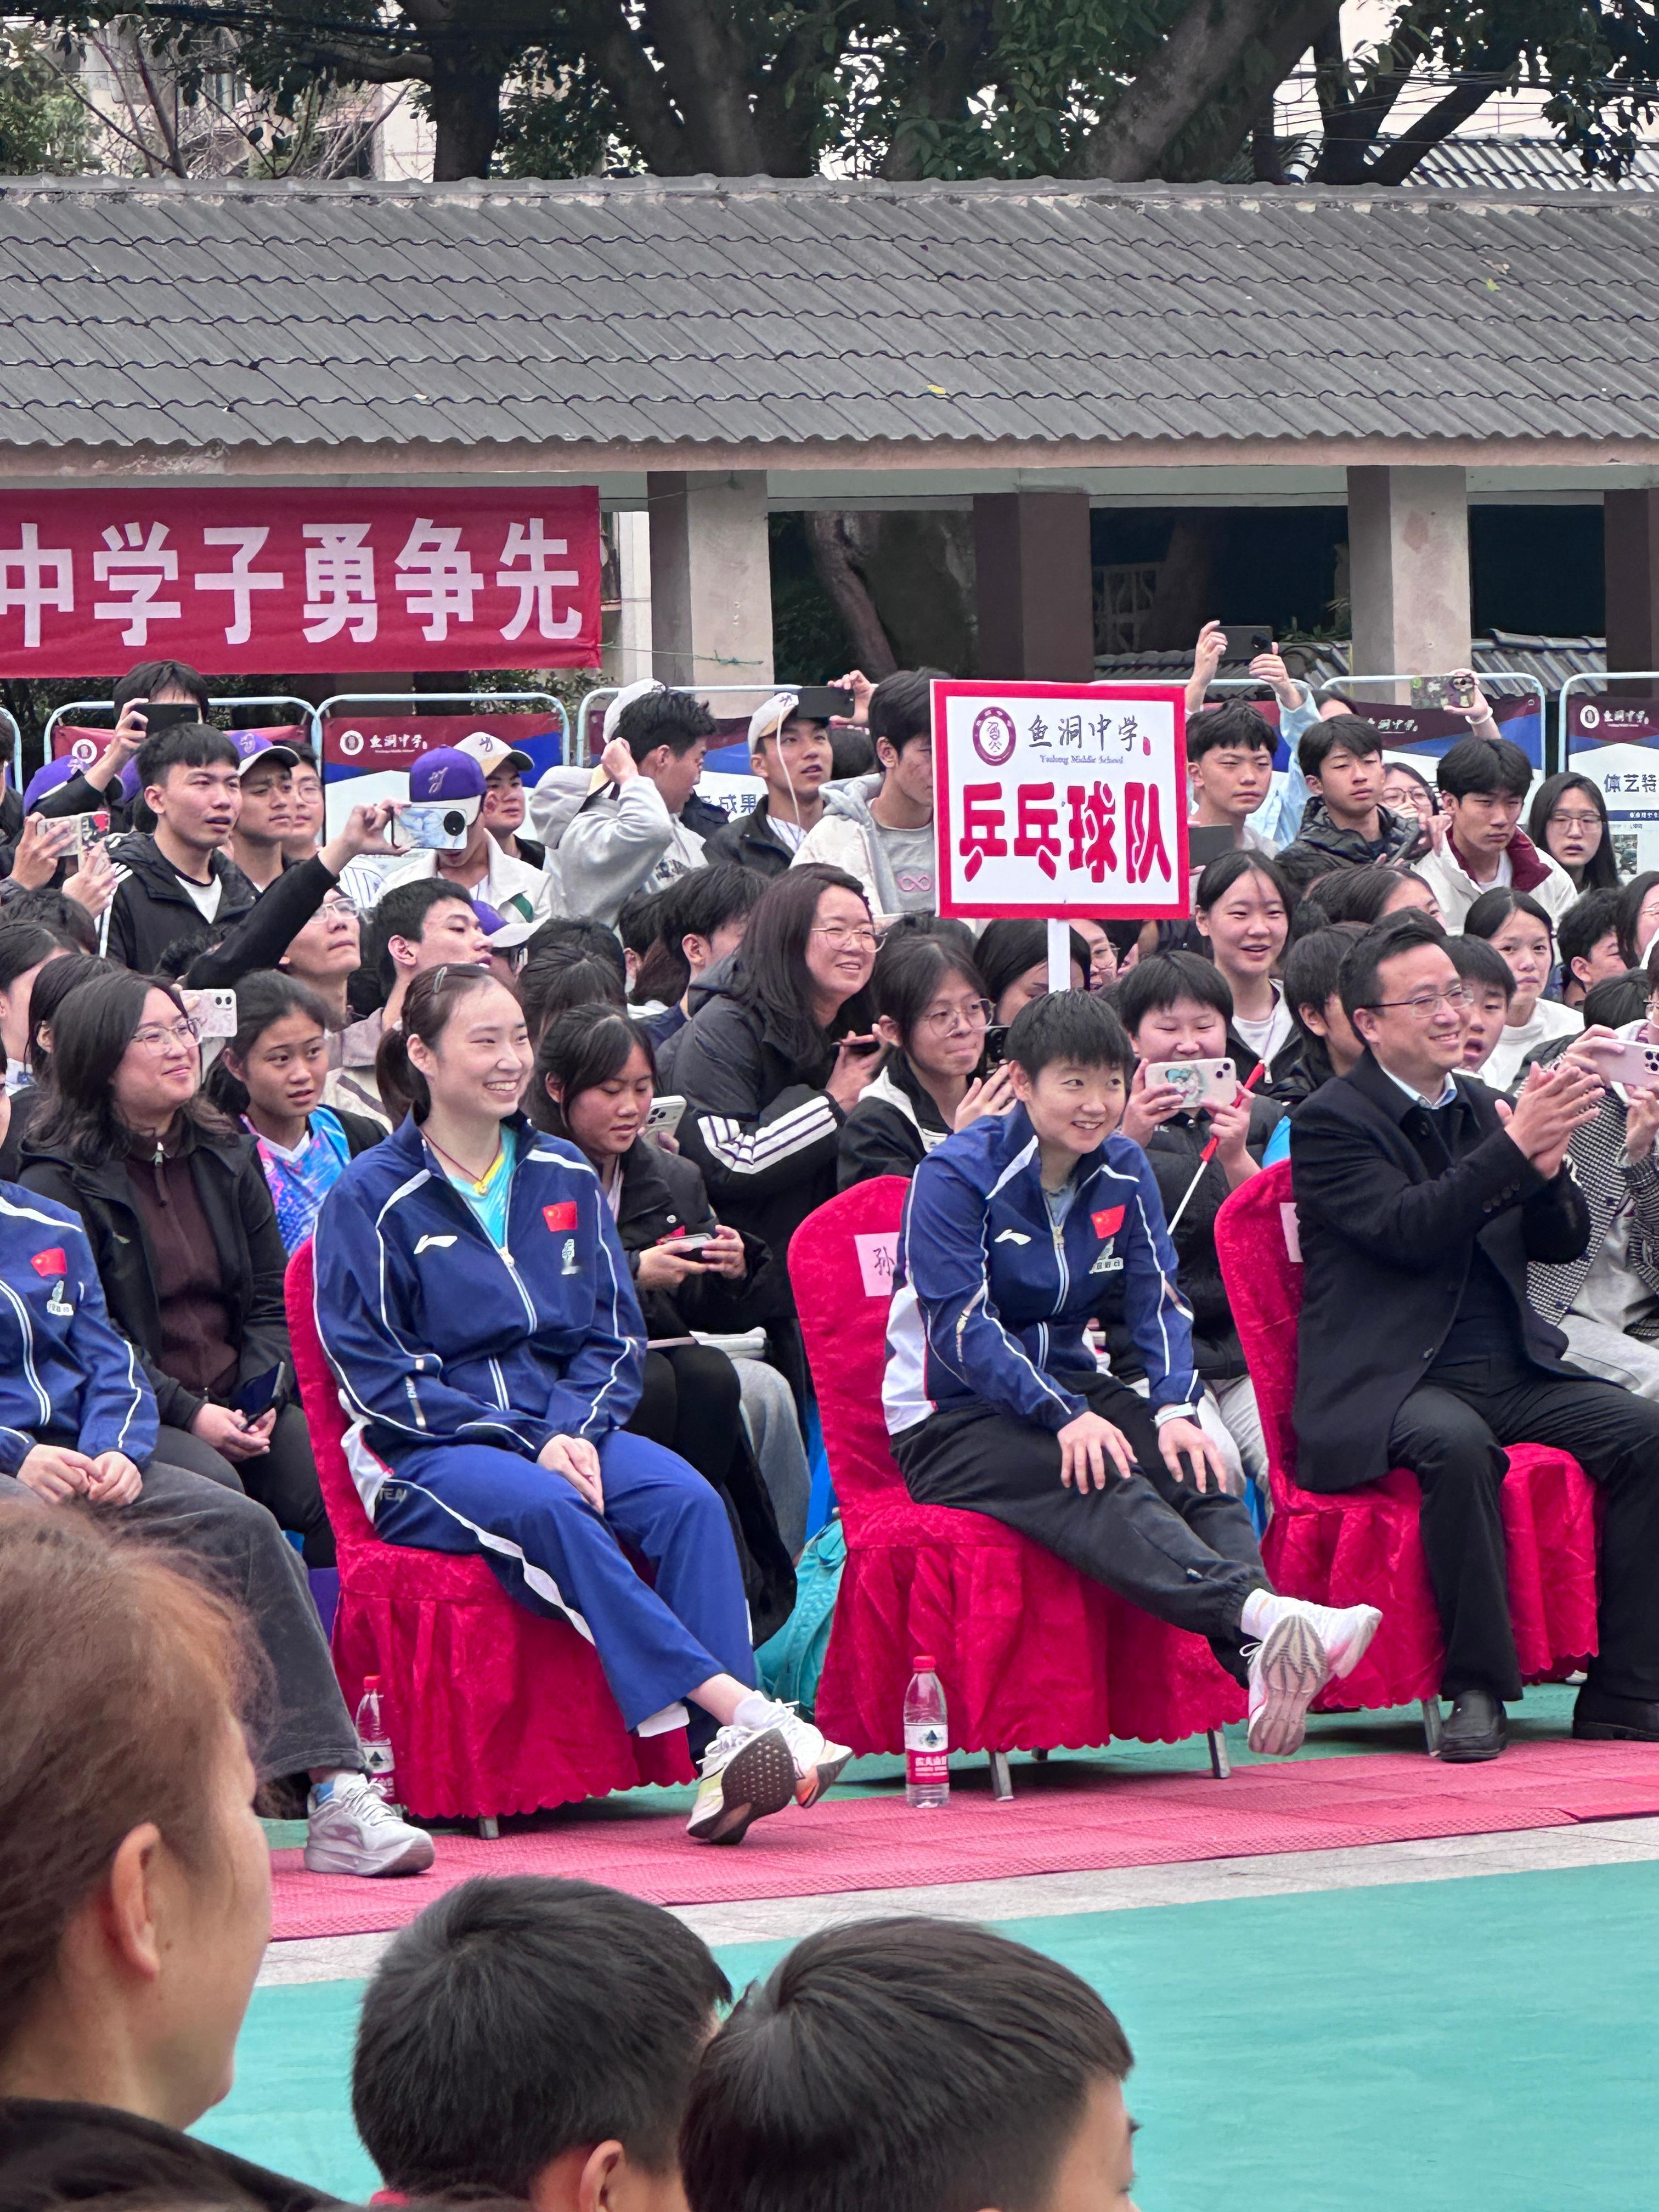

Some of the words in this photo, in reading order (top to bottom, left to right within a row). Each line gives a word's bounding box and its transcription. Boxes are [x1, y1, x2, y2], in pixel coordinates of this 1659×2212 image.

[0, 518, 582, 647] 中学子勇争先
[1029, 714, 1138, 752] 鱼洞中学
[959, 781, 1172, 883] 乒乓球队
